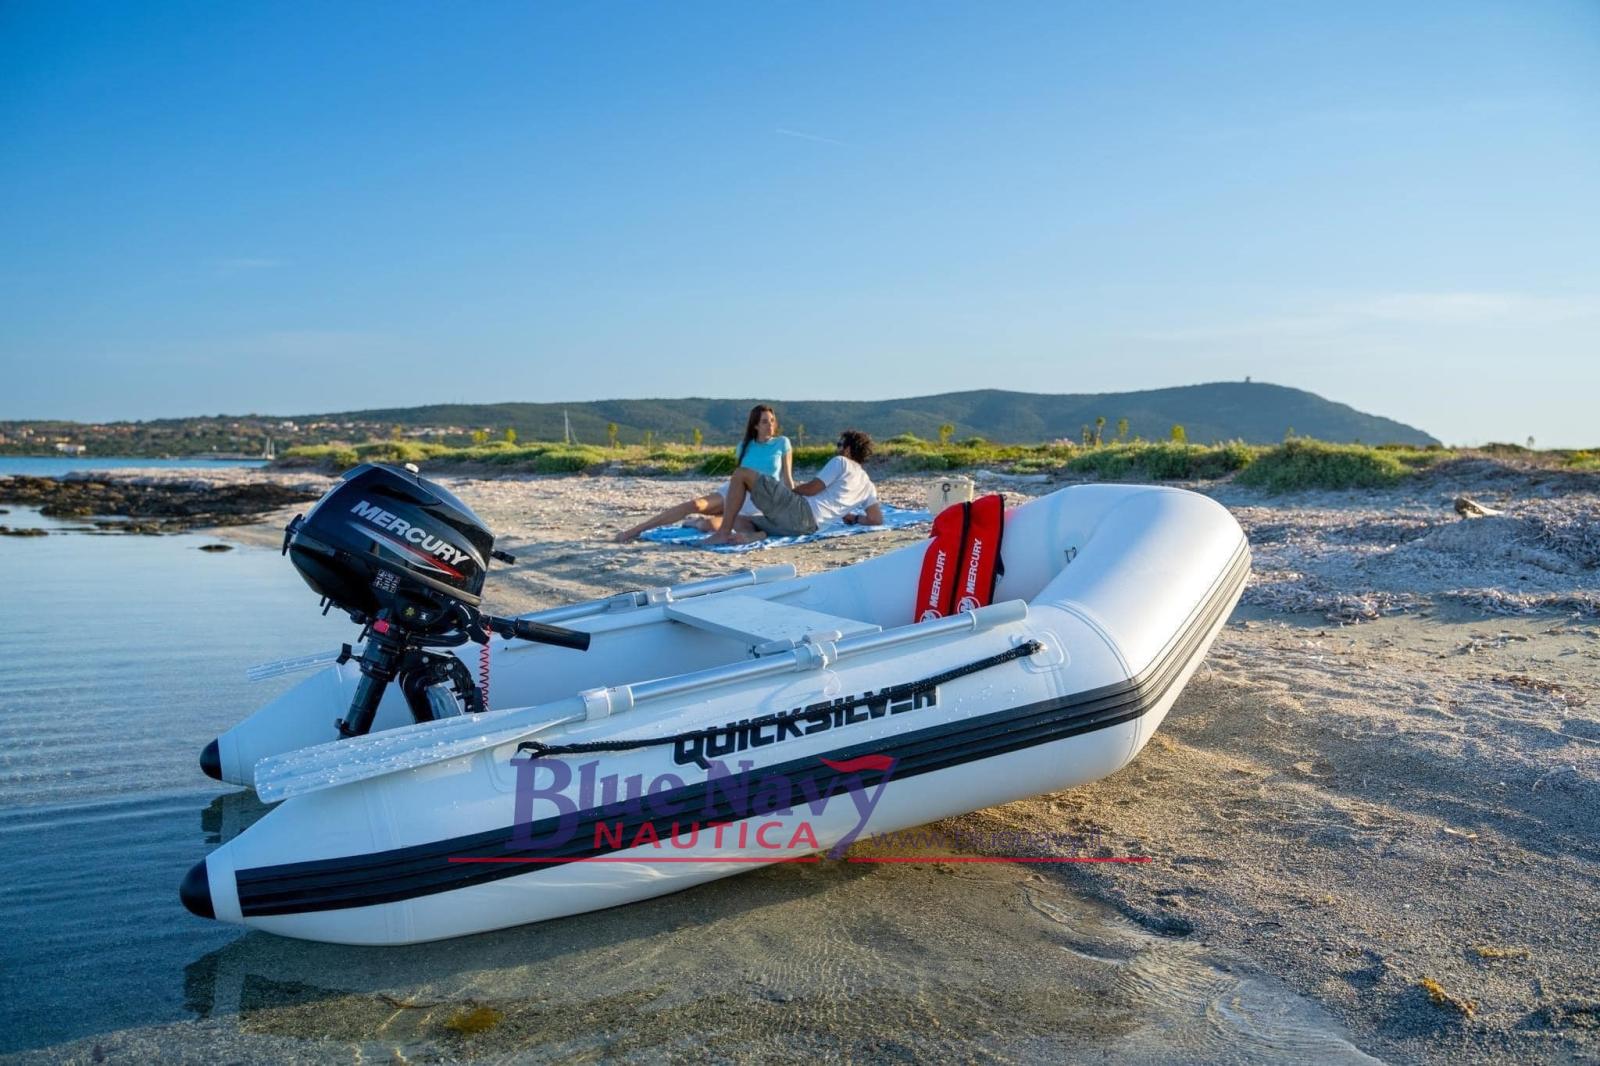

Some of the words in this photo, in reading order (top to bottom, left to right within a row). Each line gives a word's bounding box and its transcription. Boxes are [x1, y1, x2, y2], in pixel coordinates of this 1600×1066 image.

[351, 500, 472, 566] MERCURY
[929, 550, 947, 608] MERCURY
[966, 538, 982, 594] MERCURY
